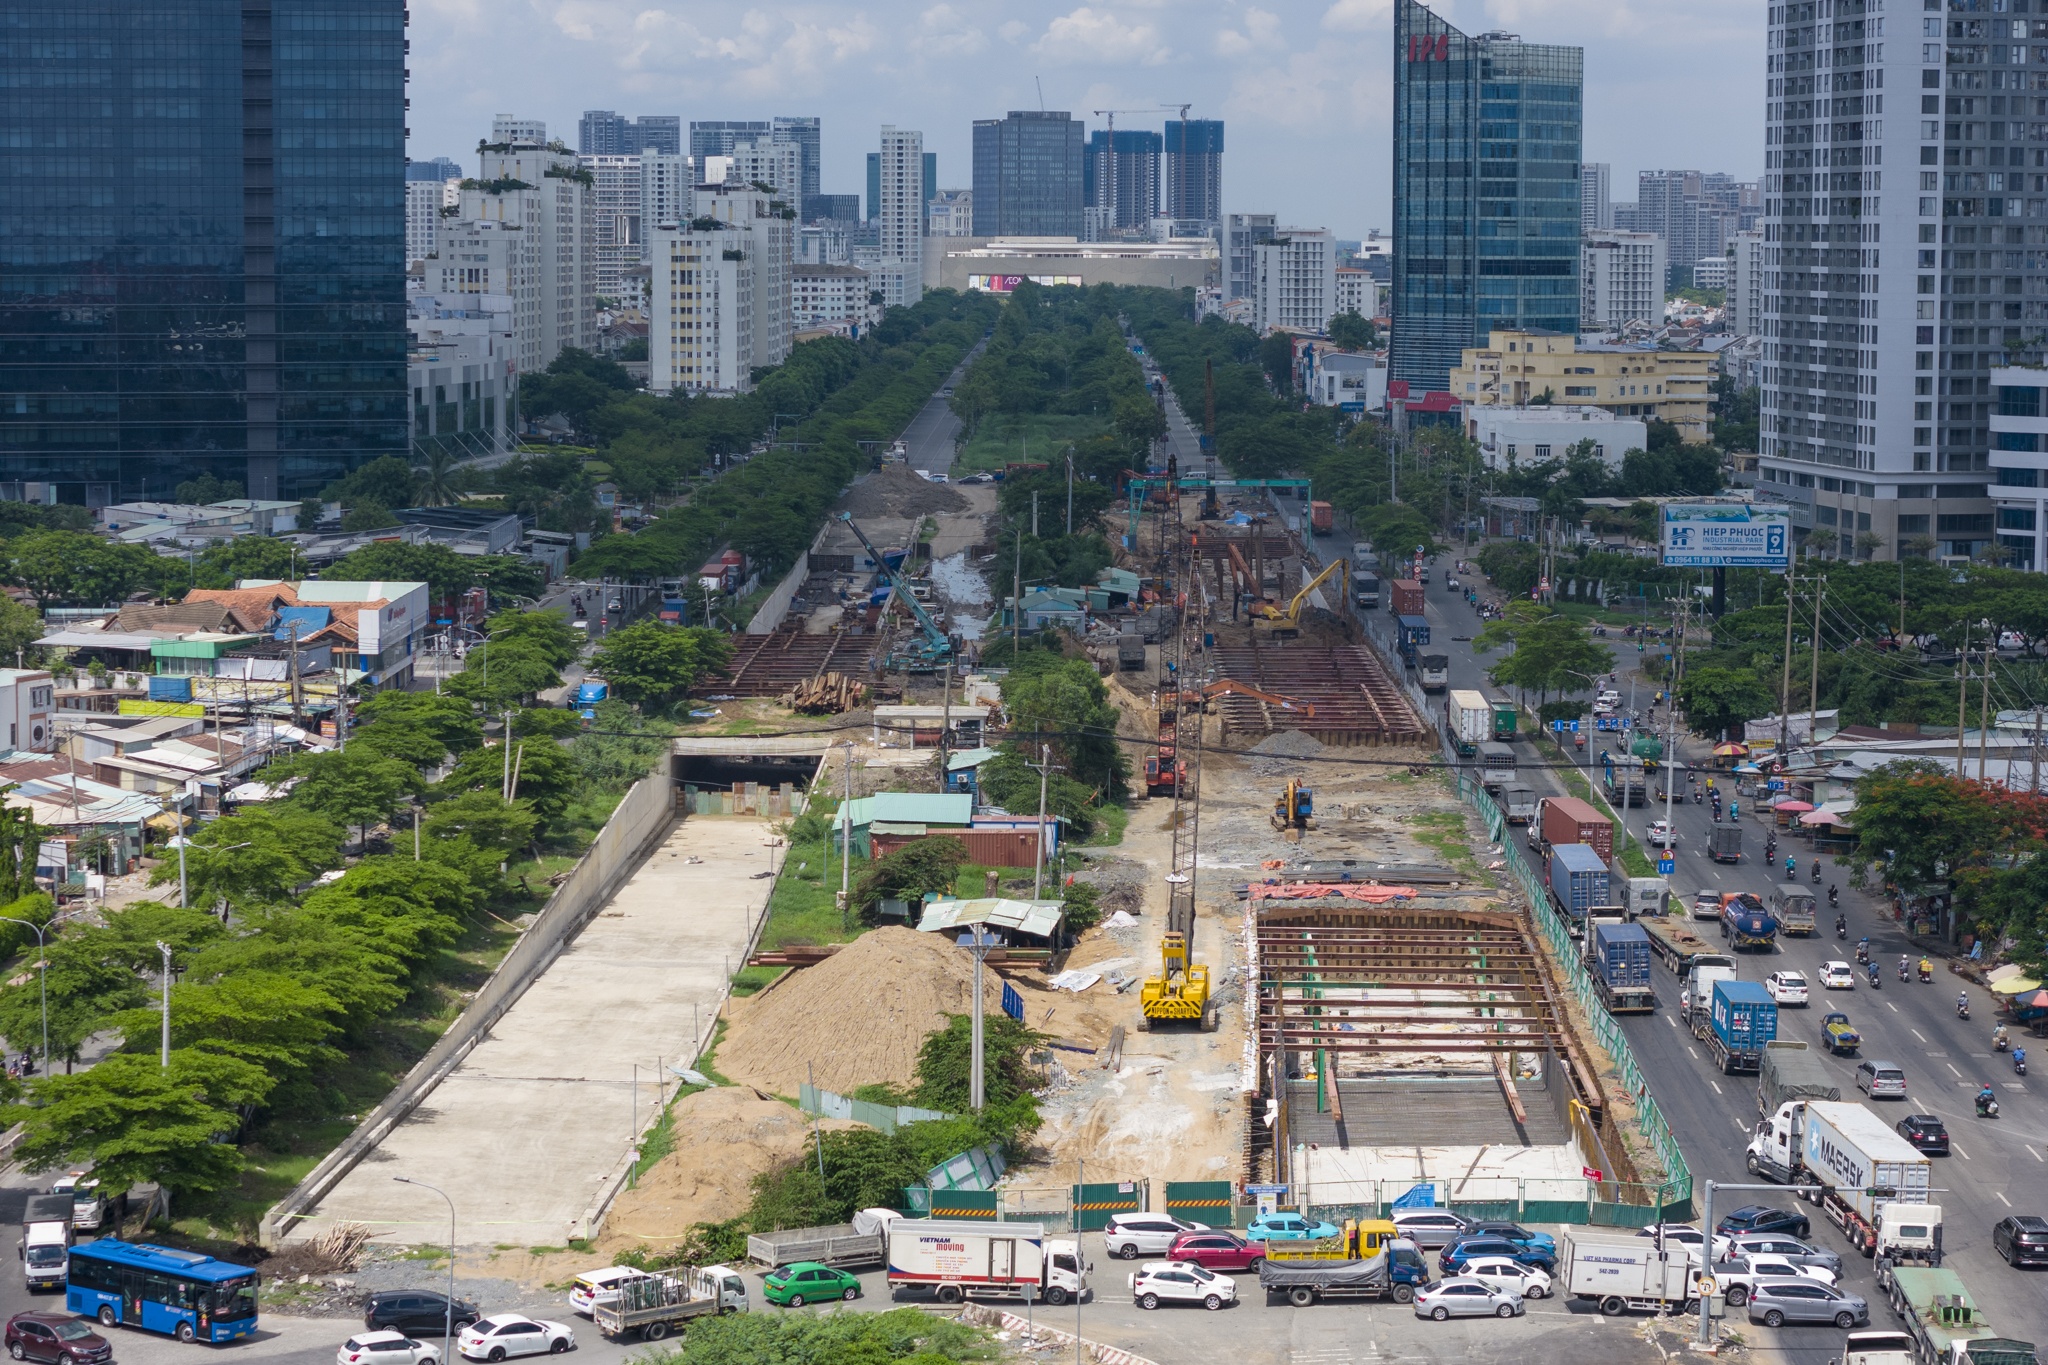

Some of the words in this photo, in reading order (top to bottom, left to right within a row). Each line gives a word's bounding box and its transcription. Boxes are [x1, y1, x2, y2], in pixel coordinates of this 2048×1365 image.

[1408, 33, 1449, 63] IPC
[1703, 528, 1727, 536] HIEP
[1729, 528, 1764, 536] PHUOC
[1702, 536, 1743, 544] INDUSTRIAL
[1745, 536, 1764, 544] PARK
[1770, 535, 1780, 548] 9
[1820, 1135, 1864, 1188] MAERSK
[936, 1243, 964, 1252] moving
